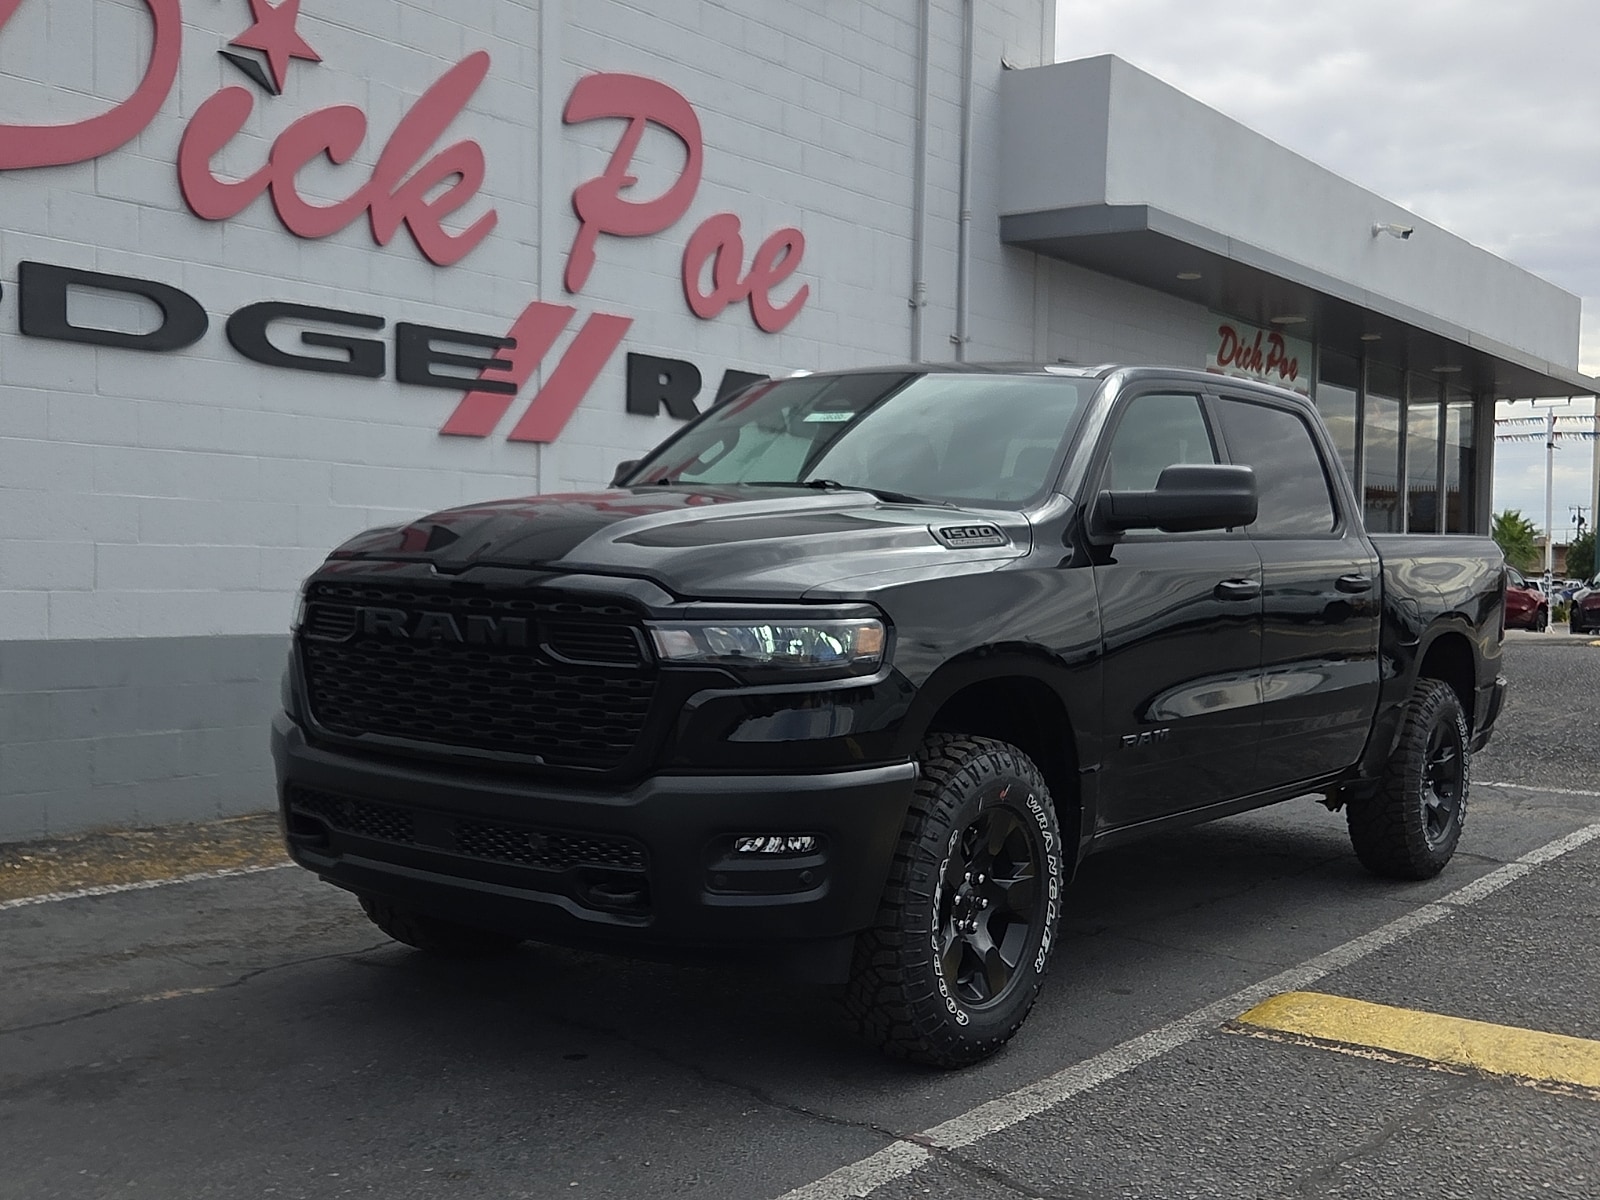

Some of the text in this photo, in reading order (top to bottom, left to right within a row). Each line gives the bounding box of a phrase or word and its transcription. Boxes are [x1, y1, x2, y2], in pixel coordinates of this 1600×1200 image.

[563, 72, 809, 334] Poe
[0, 260, 518, 395] DGE
[1217, 325, 1298, 382] Dick Poe
[943, 527, 994, 539] 1500
[358, 606, 528, 648] RAM
[1026, 793, 1058, 974] WRANGLER
